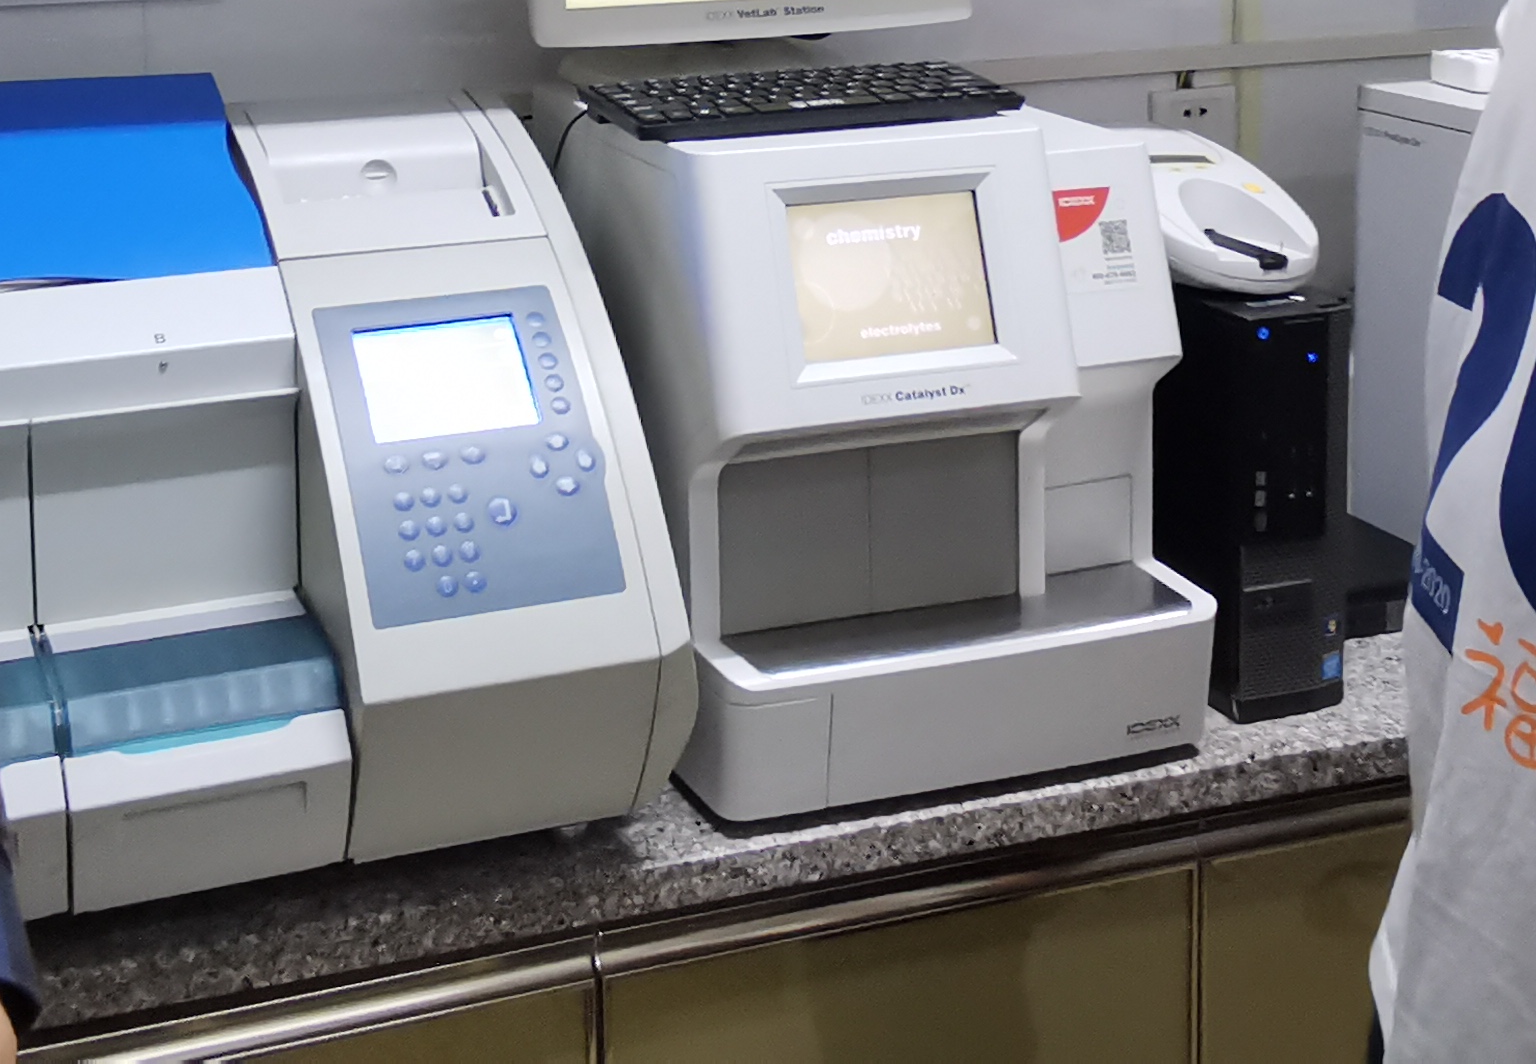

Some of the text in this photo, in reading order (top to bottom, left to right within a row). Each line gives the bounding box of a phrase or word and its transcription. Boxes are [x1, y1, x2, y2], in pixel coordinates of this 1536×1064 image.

[736, 8, 777, 19] VetLab
[783, 5, 825, 16] Station
[825, 223, 921, 246] chemistry
[154, 333, 166, 344] B
[859, 320, 942, 339] electrolytes
[895, 386, 946, 402] Catalyst
[949, 385, 966, 396] Dx
[1126, 714, 1181, 735] IDEXX
